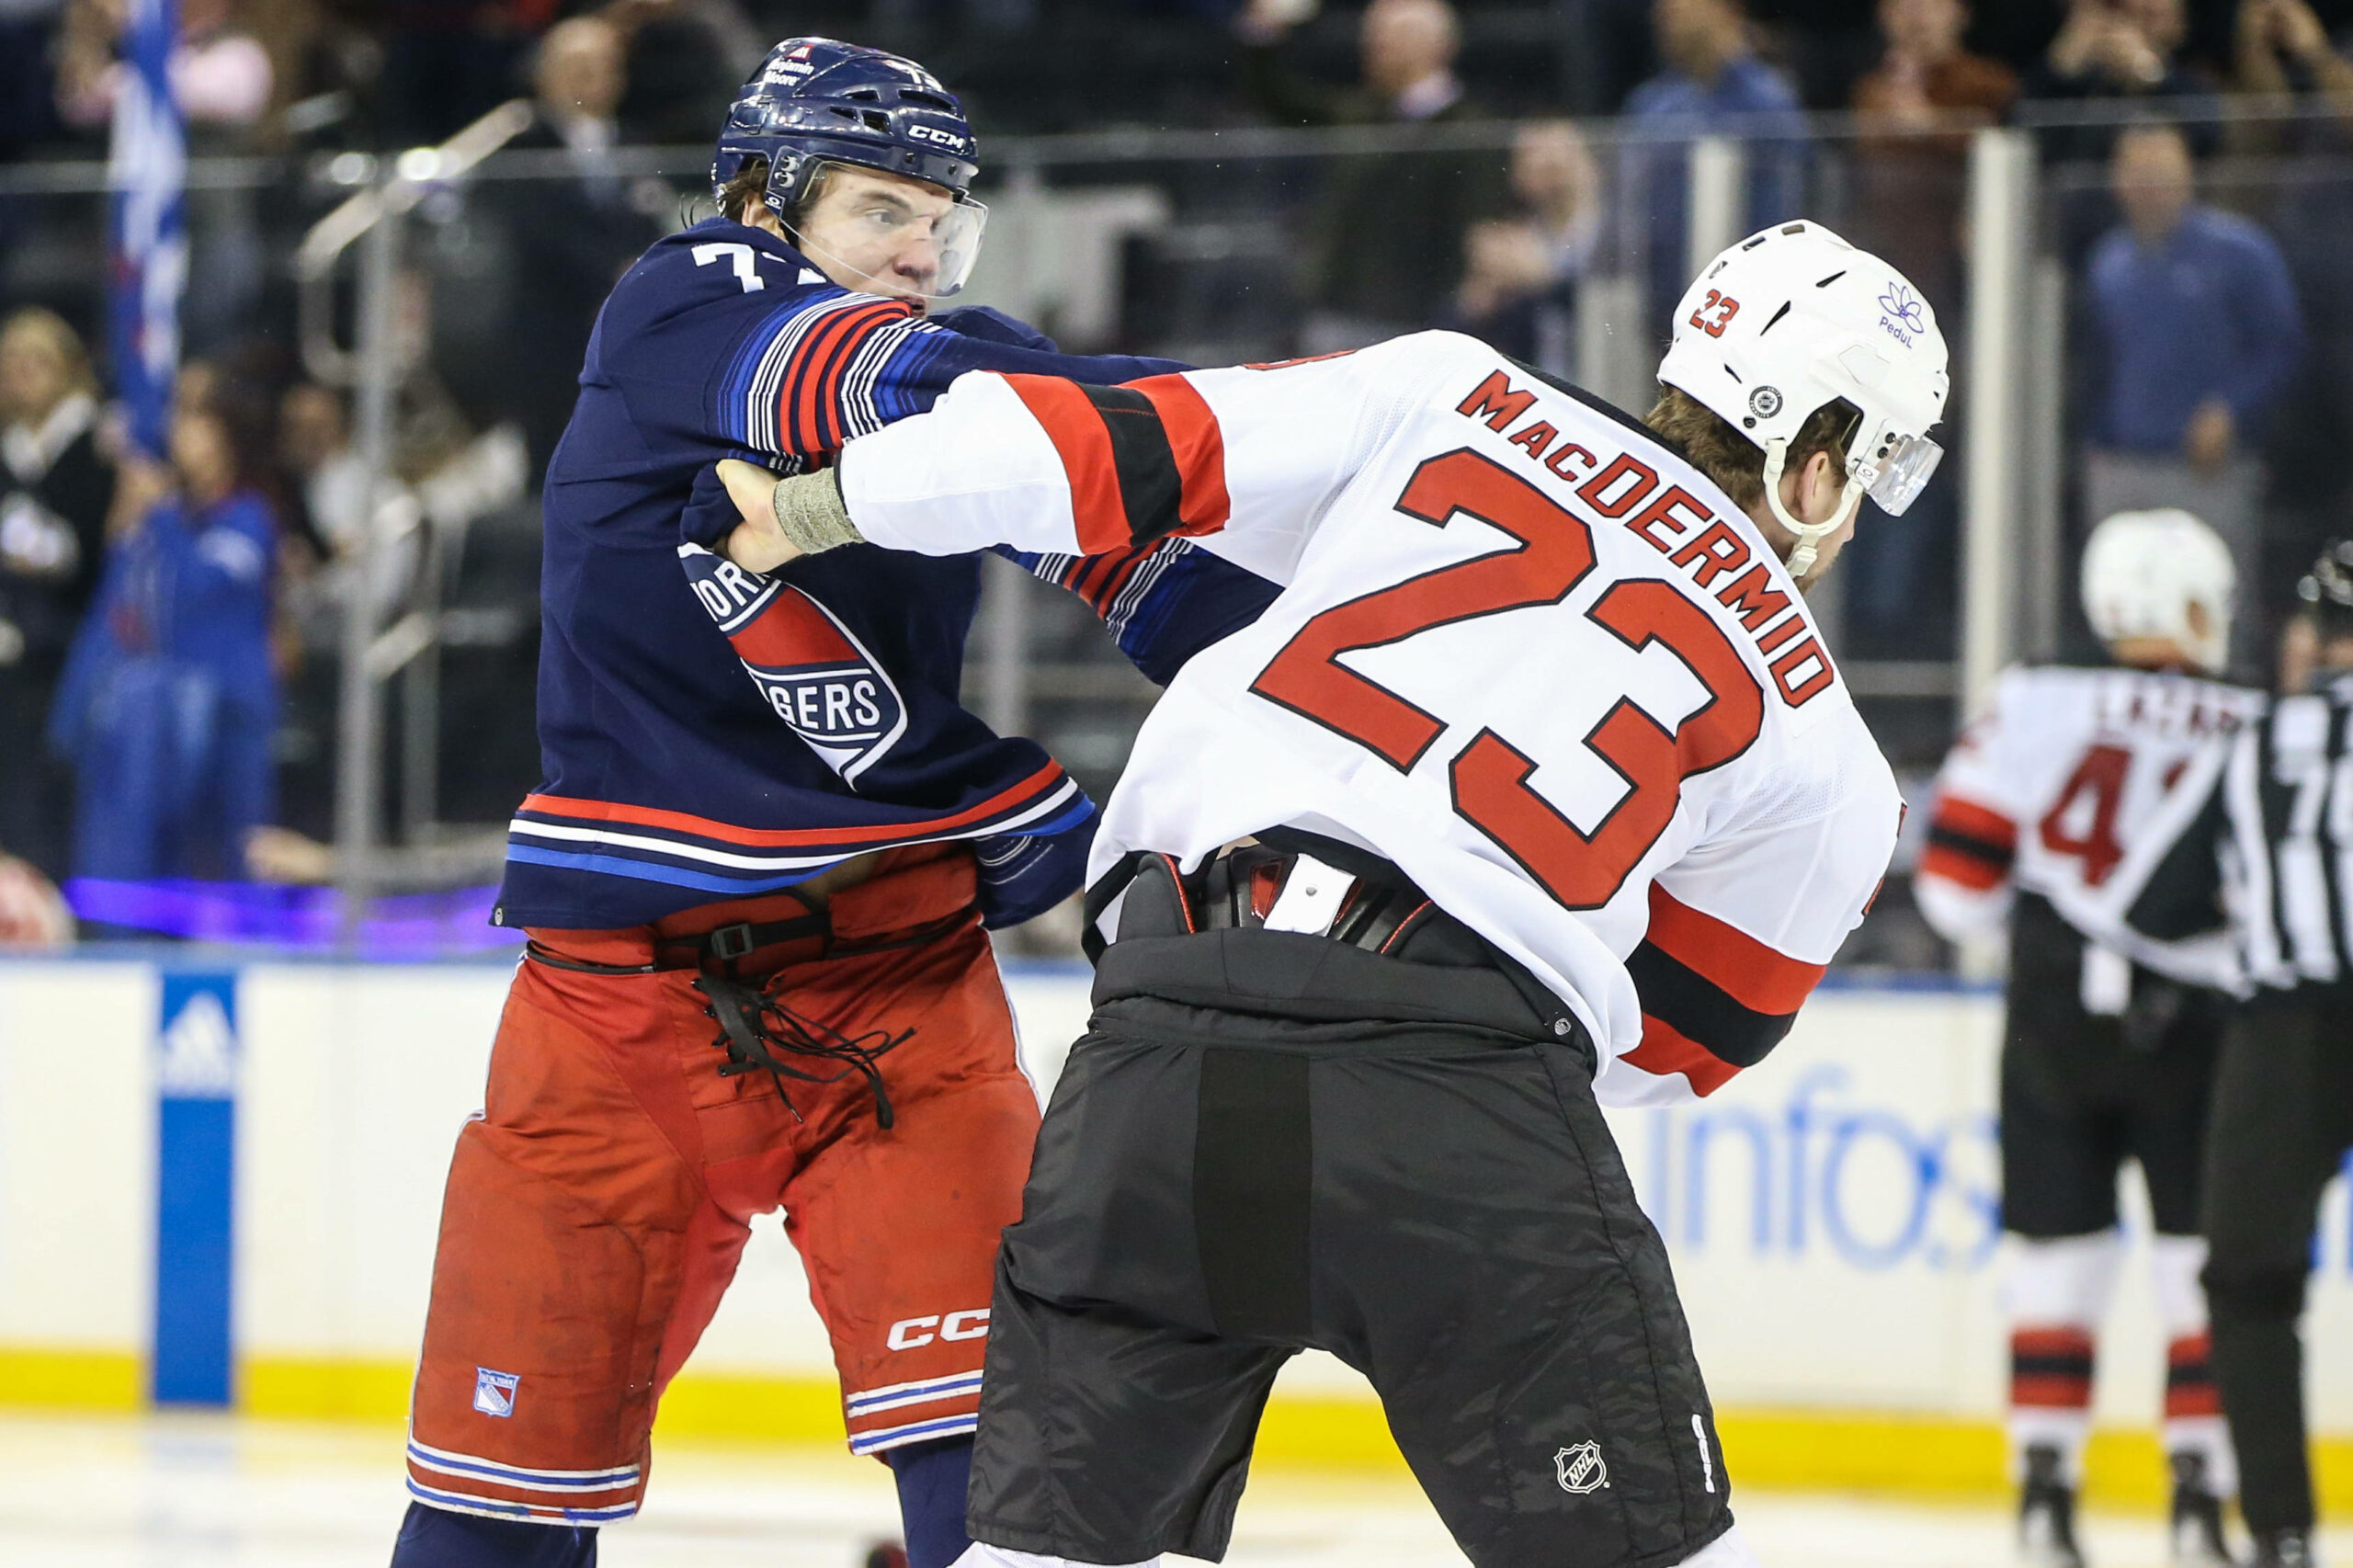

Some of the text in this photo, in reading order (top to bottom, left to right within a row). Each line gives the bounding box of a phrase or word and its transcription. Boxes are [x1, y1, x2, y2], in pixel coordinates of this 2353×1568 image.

[908, 125, 965, 148] CCM
[1689, 289, 1740, 338] 23
[690, 561, 770, 622] OR
[1248, 446, 1765, 911] 23
[1568, 1452, 1594, 1485] NHL
